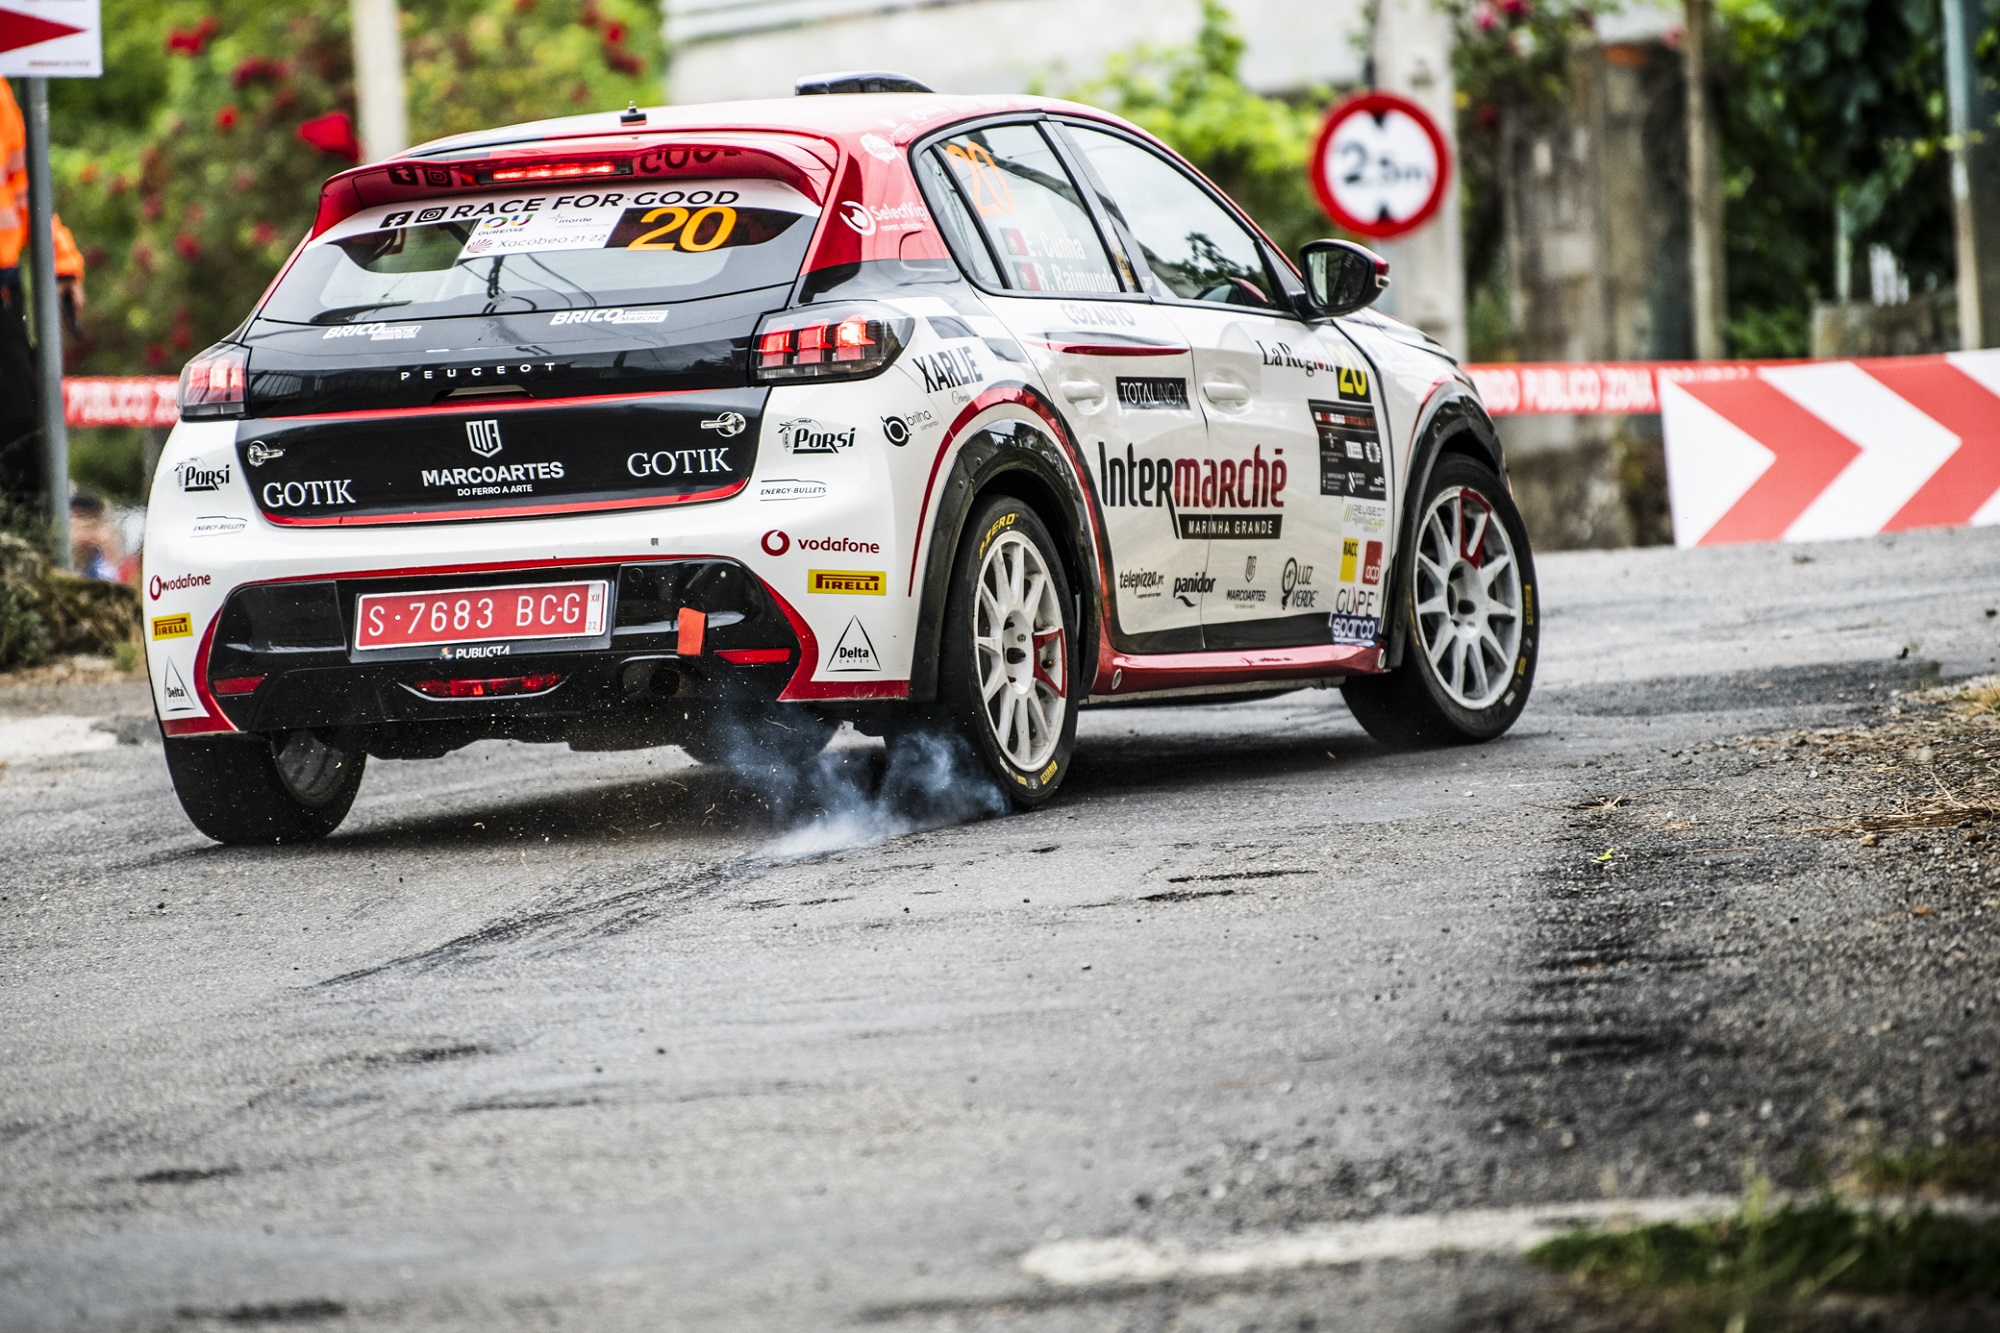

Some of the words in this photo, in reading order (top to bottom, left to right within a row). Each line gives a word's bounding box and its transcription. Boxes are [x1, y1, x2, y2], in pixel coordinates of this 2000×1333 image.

[946, 141, 1015, 217] 20
[450, 197, 546, 219] RACE
[552, 193, 624, 210] FOR
[633, 190, 740, 206] GOOD
[478, 226, 525, 236] OURENSE
[627, 206, 737, 252] 20
[497, 236, 567, 249] Xacobeo
[549, 308, 624, 325] BRICO
[322, 322, 386, 339] BRICO
[400, 361, 556, 380] PEUGEOT
[912, 346, 984, 394] XARLIE
[1334, 350, 1368, 397] 20
[626, 447, 733, 477] GOTIK
[421, 461, 565, 487] MARCOARTES
[263, 479, 356, 508] GOTIK
[457, 488, 471, 497] DO
[472, 486, 501, 496] FERRO
[502, 486, 510, 494] A
[510, 484, 533, 493] ARTE
[984, 513, 1016, 548] ZERO
[1188, 520, 1230, 534] MARINHA
[1234, 520, 1273, 534] GRANDE
[798, 536, 880, 554] vodafone
[1343, 541, 1359, 558] RACC
[162, 573, 211, 591] vodafone
[815, 573, 880, 591] PIRELLI
[1172, 572, 1217, 598] panidor
[1297, 565, 1314, 586] LUZ
[1226, 589, 1267, 602] MARCOARTES
[1291, 589, 1319, 609] VERDE
[407, 597, 494, 634] 7683
[516, 592, 581, 627] BCG
[154, 617, 188, 637] PIRELLI
[587, 621, 597, 631] 22
[1333, 617, 1377, 640] sparco
[839, 646, 869, 659] Delta
[166, 686, 185, 698] Delta
